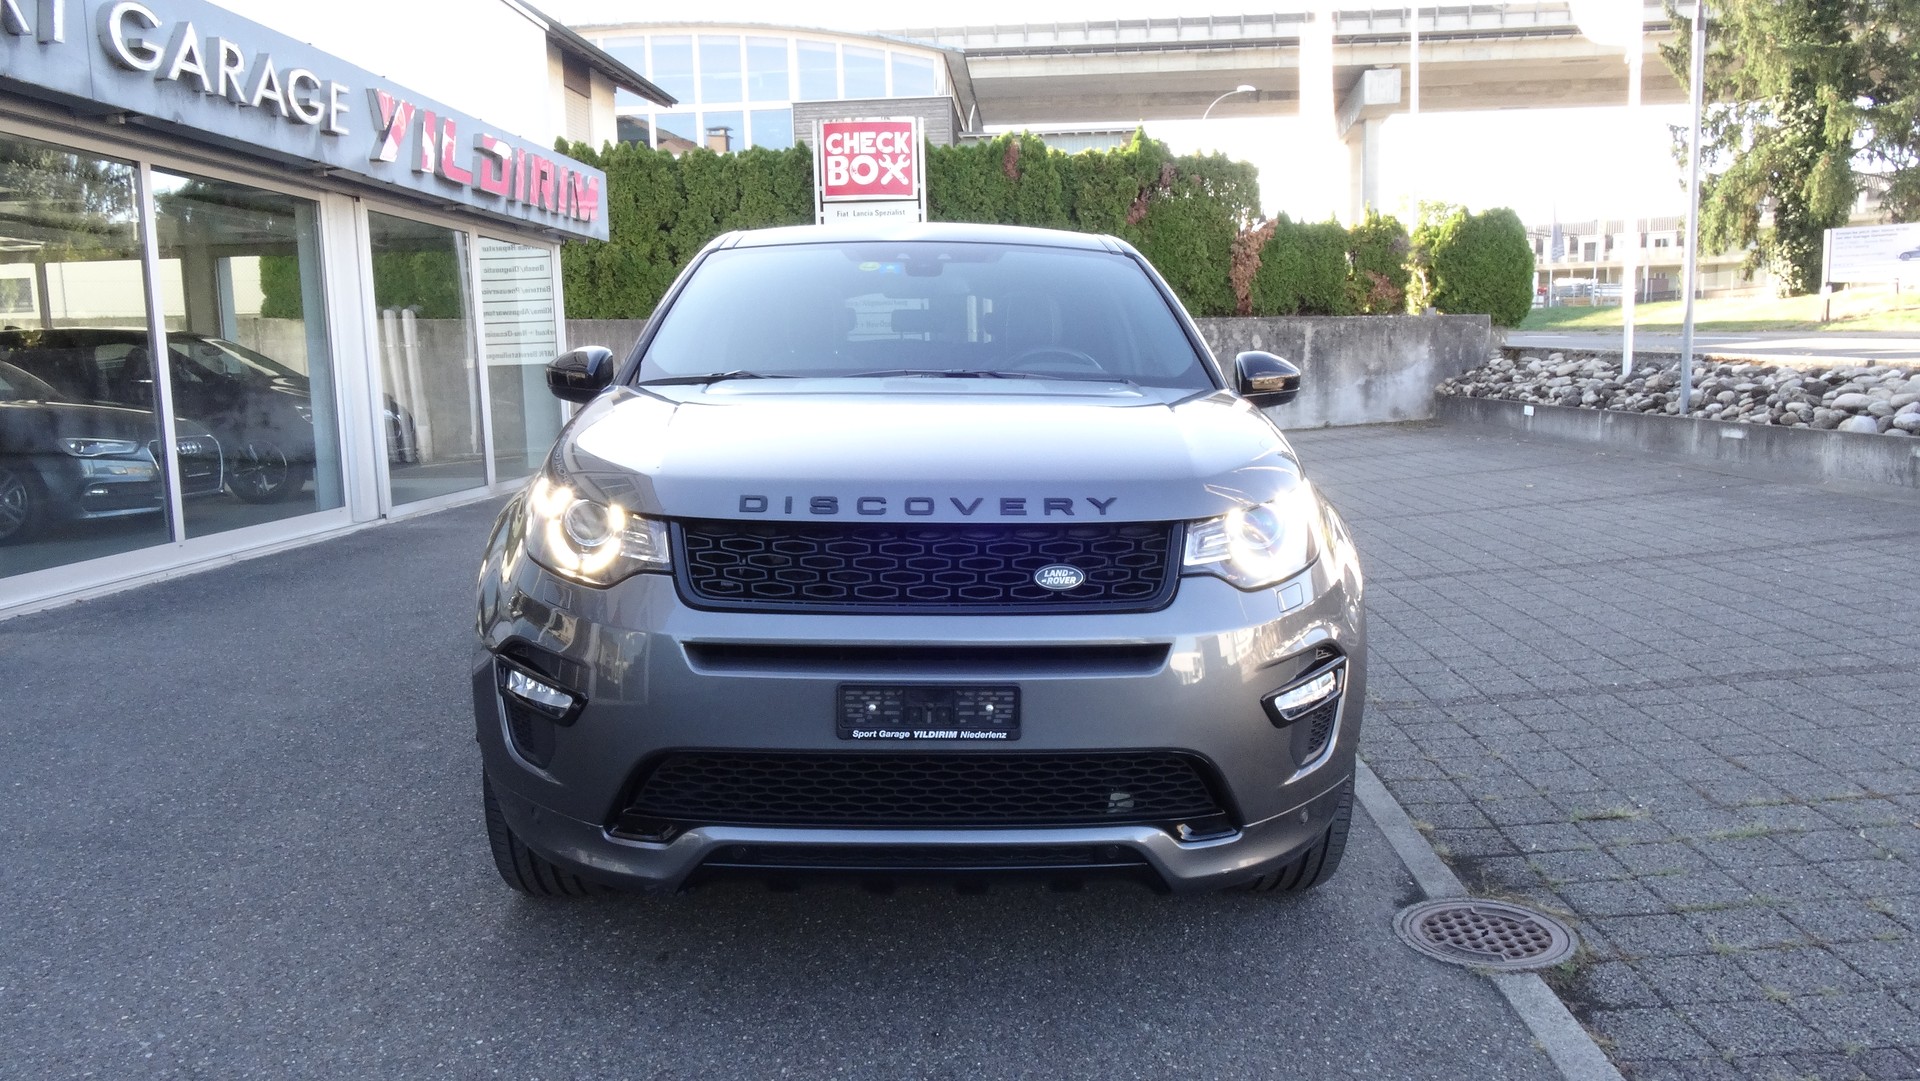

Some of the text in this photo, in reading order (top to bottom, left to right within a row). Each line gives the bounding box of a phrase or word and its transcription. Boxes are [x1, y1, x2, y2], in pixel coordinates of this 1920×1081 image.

[100, 1, 599, 222] GARAGE YILDIRIM
[826, 131, 910, 154] CHECK
[827, 154, 910, 186] BOX
[874, 209, 906, 218] Spezialist
[739, 494, 1118, 516] DISCOVERY
[1044, 569, 1068, 577] LAND
[1046, 576, 1077, 585] ROVER
[852, 730, 877, 739] Sport
[879, 730, 910, 739] Garage
[960, 731, 1007, 739] Niederlenz
